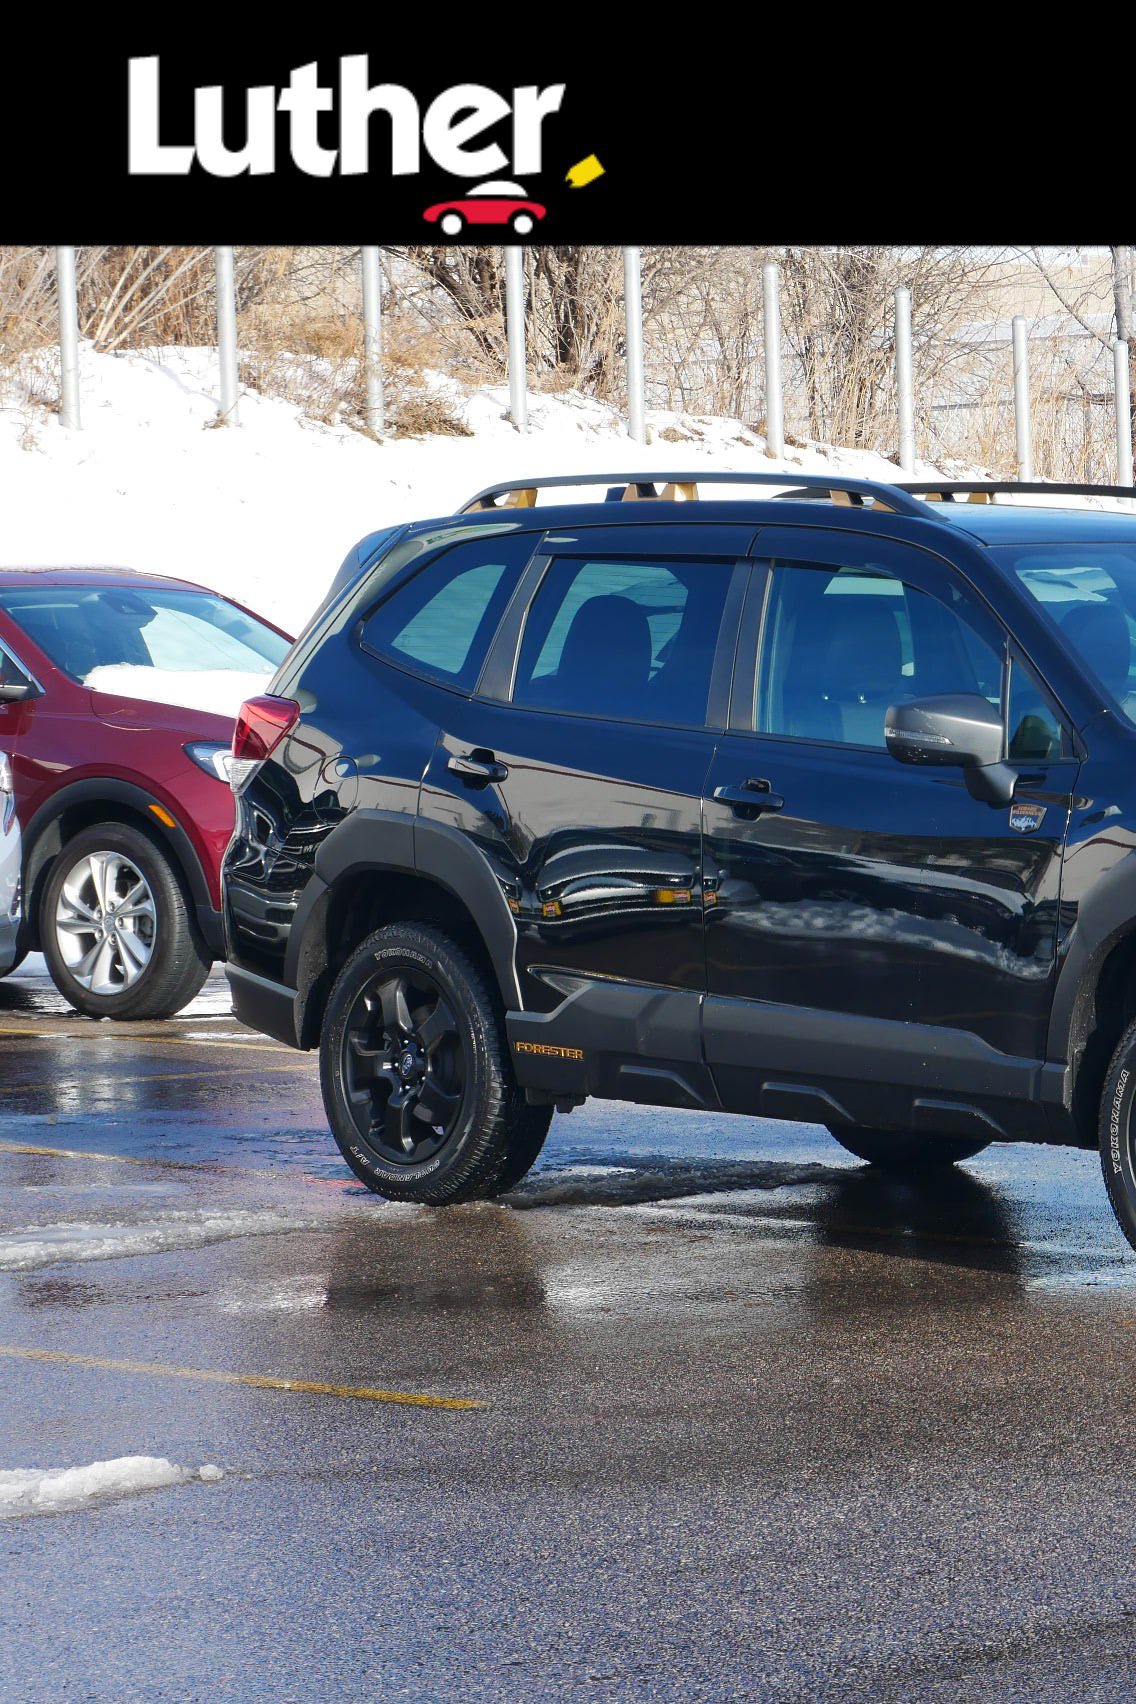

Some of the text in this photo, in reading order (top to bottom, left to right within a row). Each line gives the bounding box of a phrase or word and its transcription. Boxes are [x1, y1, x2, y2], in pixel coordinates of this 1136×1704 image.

[374, 946, 433, 969] YOKOHAMA
[515, 1041, 585, 1060] FORESTER
[1110, 1069, 1130, 1174] YOKOHAMA
